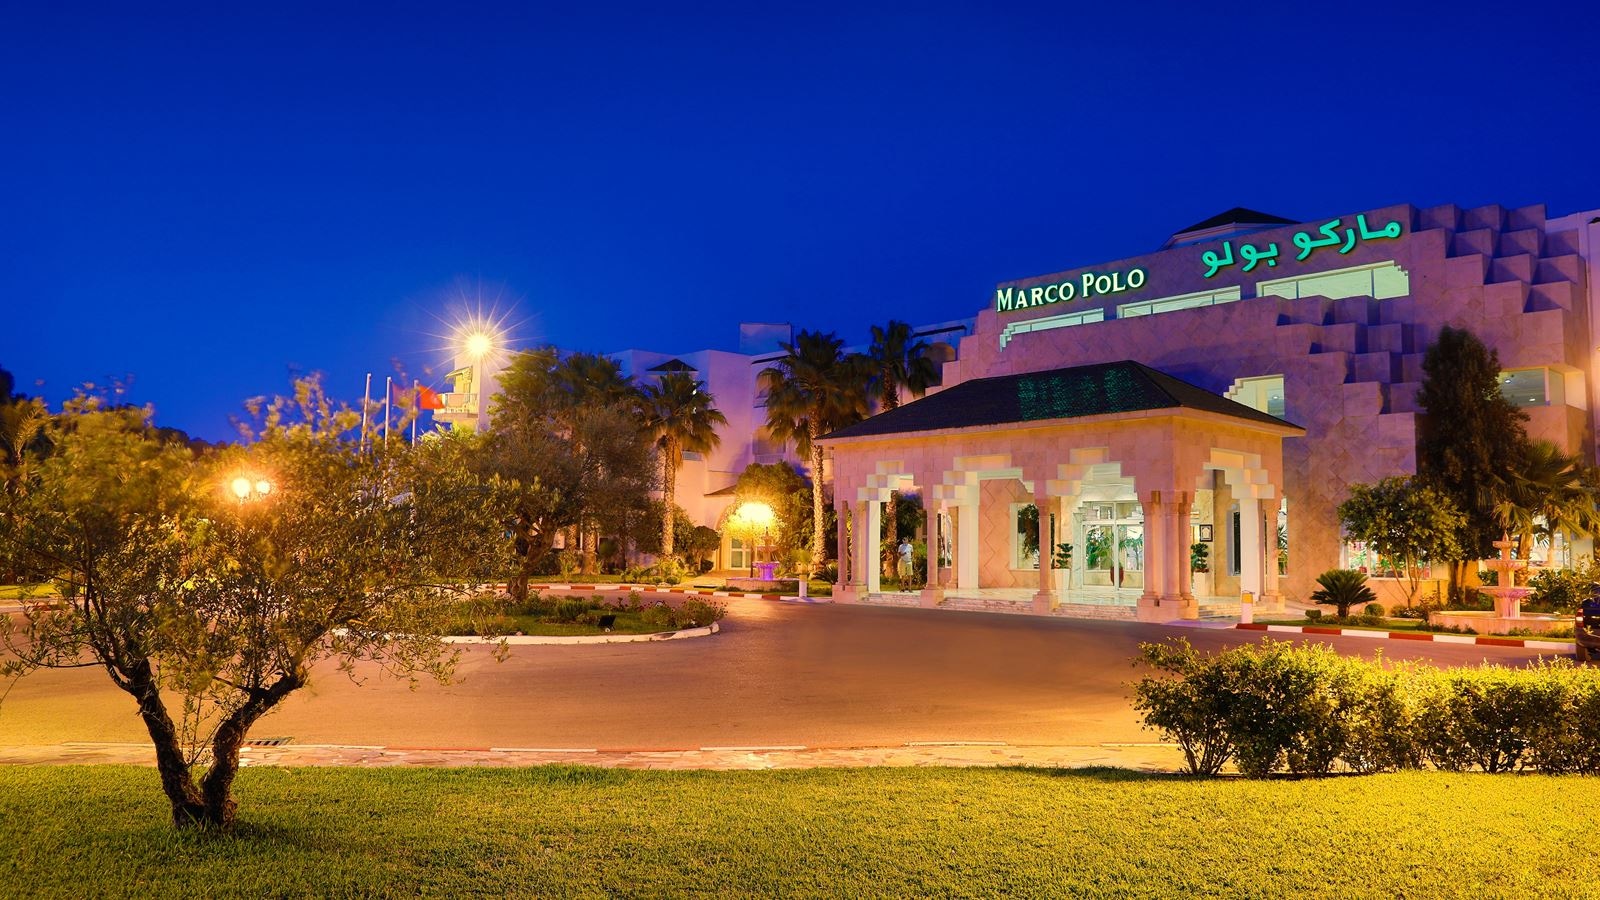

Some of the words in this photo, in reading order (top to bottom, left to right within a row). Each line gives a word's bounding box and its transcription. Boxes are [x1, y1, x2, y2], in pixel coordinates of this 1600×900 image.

[1293, 214, 1401, 260] ماركو
[1202, 241, 1278, 278] بولو
[996, 284, 1074, 312] MARCO
[1082, 268, 1145, 298] POLO
